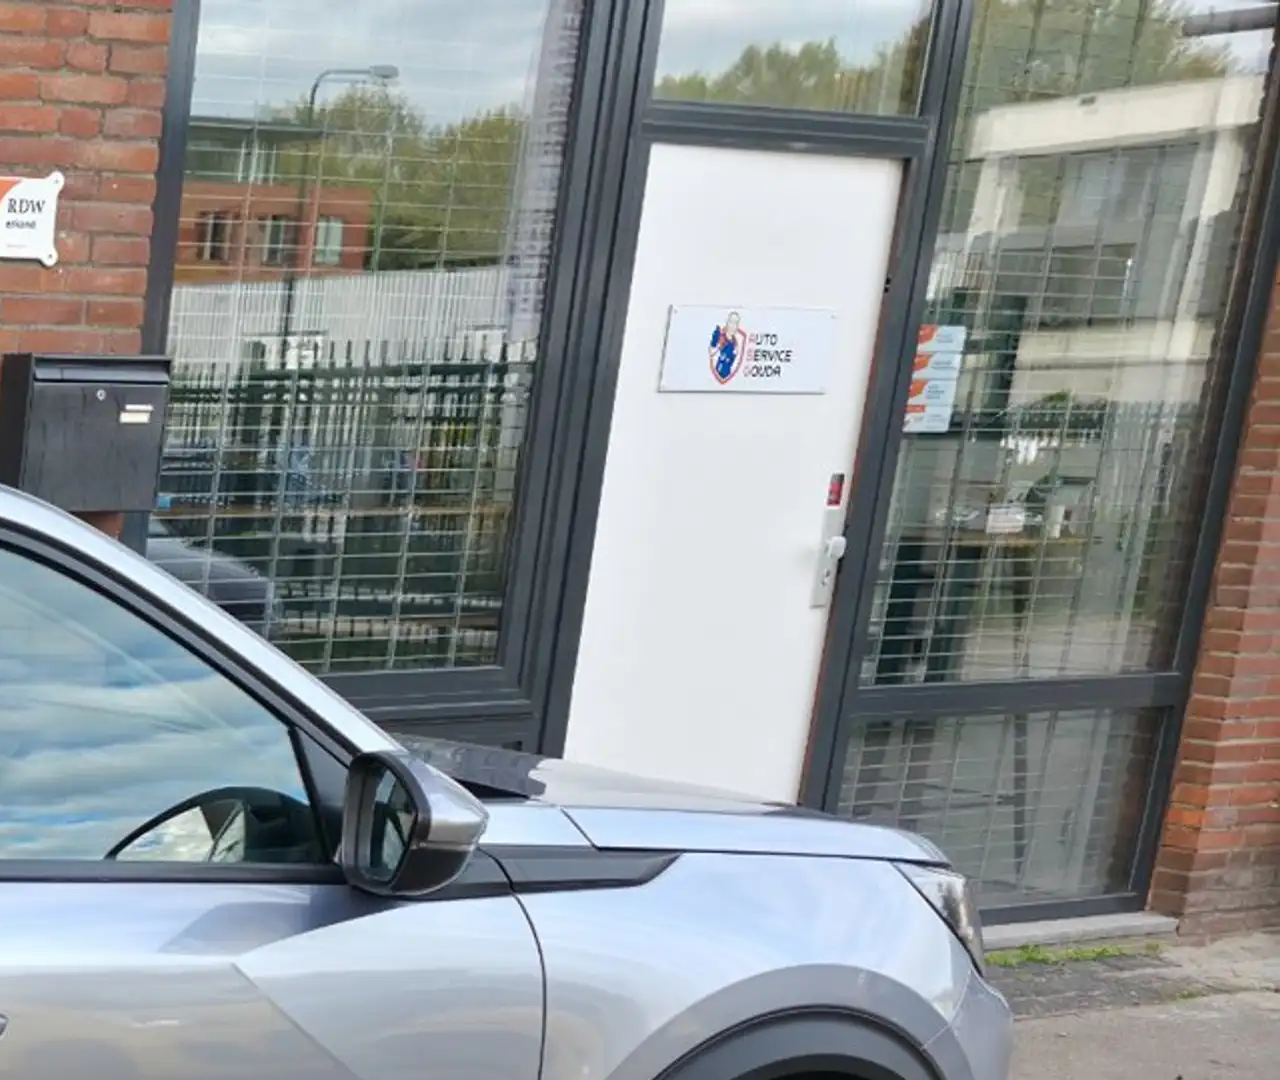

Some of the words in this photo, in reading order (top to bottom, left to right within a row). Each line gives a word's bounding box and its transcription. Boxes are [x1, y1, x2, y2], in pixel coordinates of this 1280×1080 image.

[7, 198, 46, 214] RDW
[748, 332, 778, 346] AUTO
[746, 348, 793, 363] SERVICE
[742, 364, 782, 378] GOUDA
